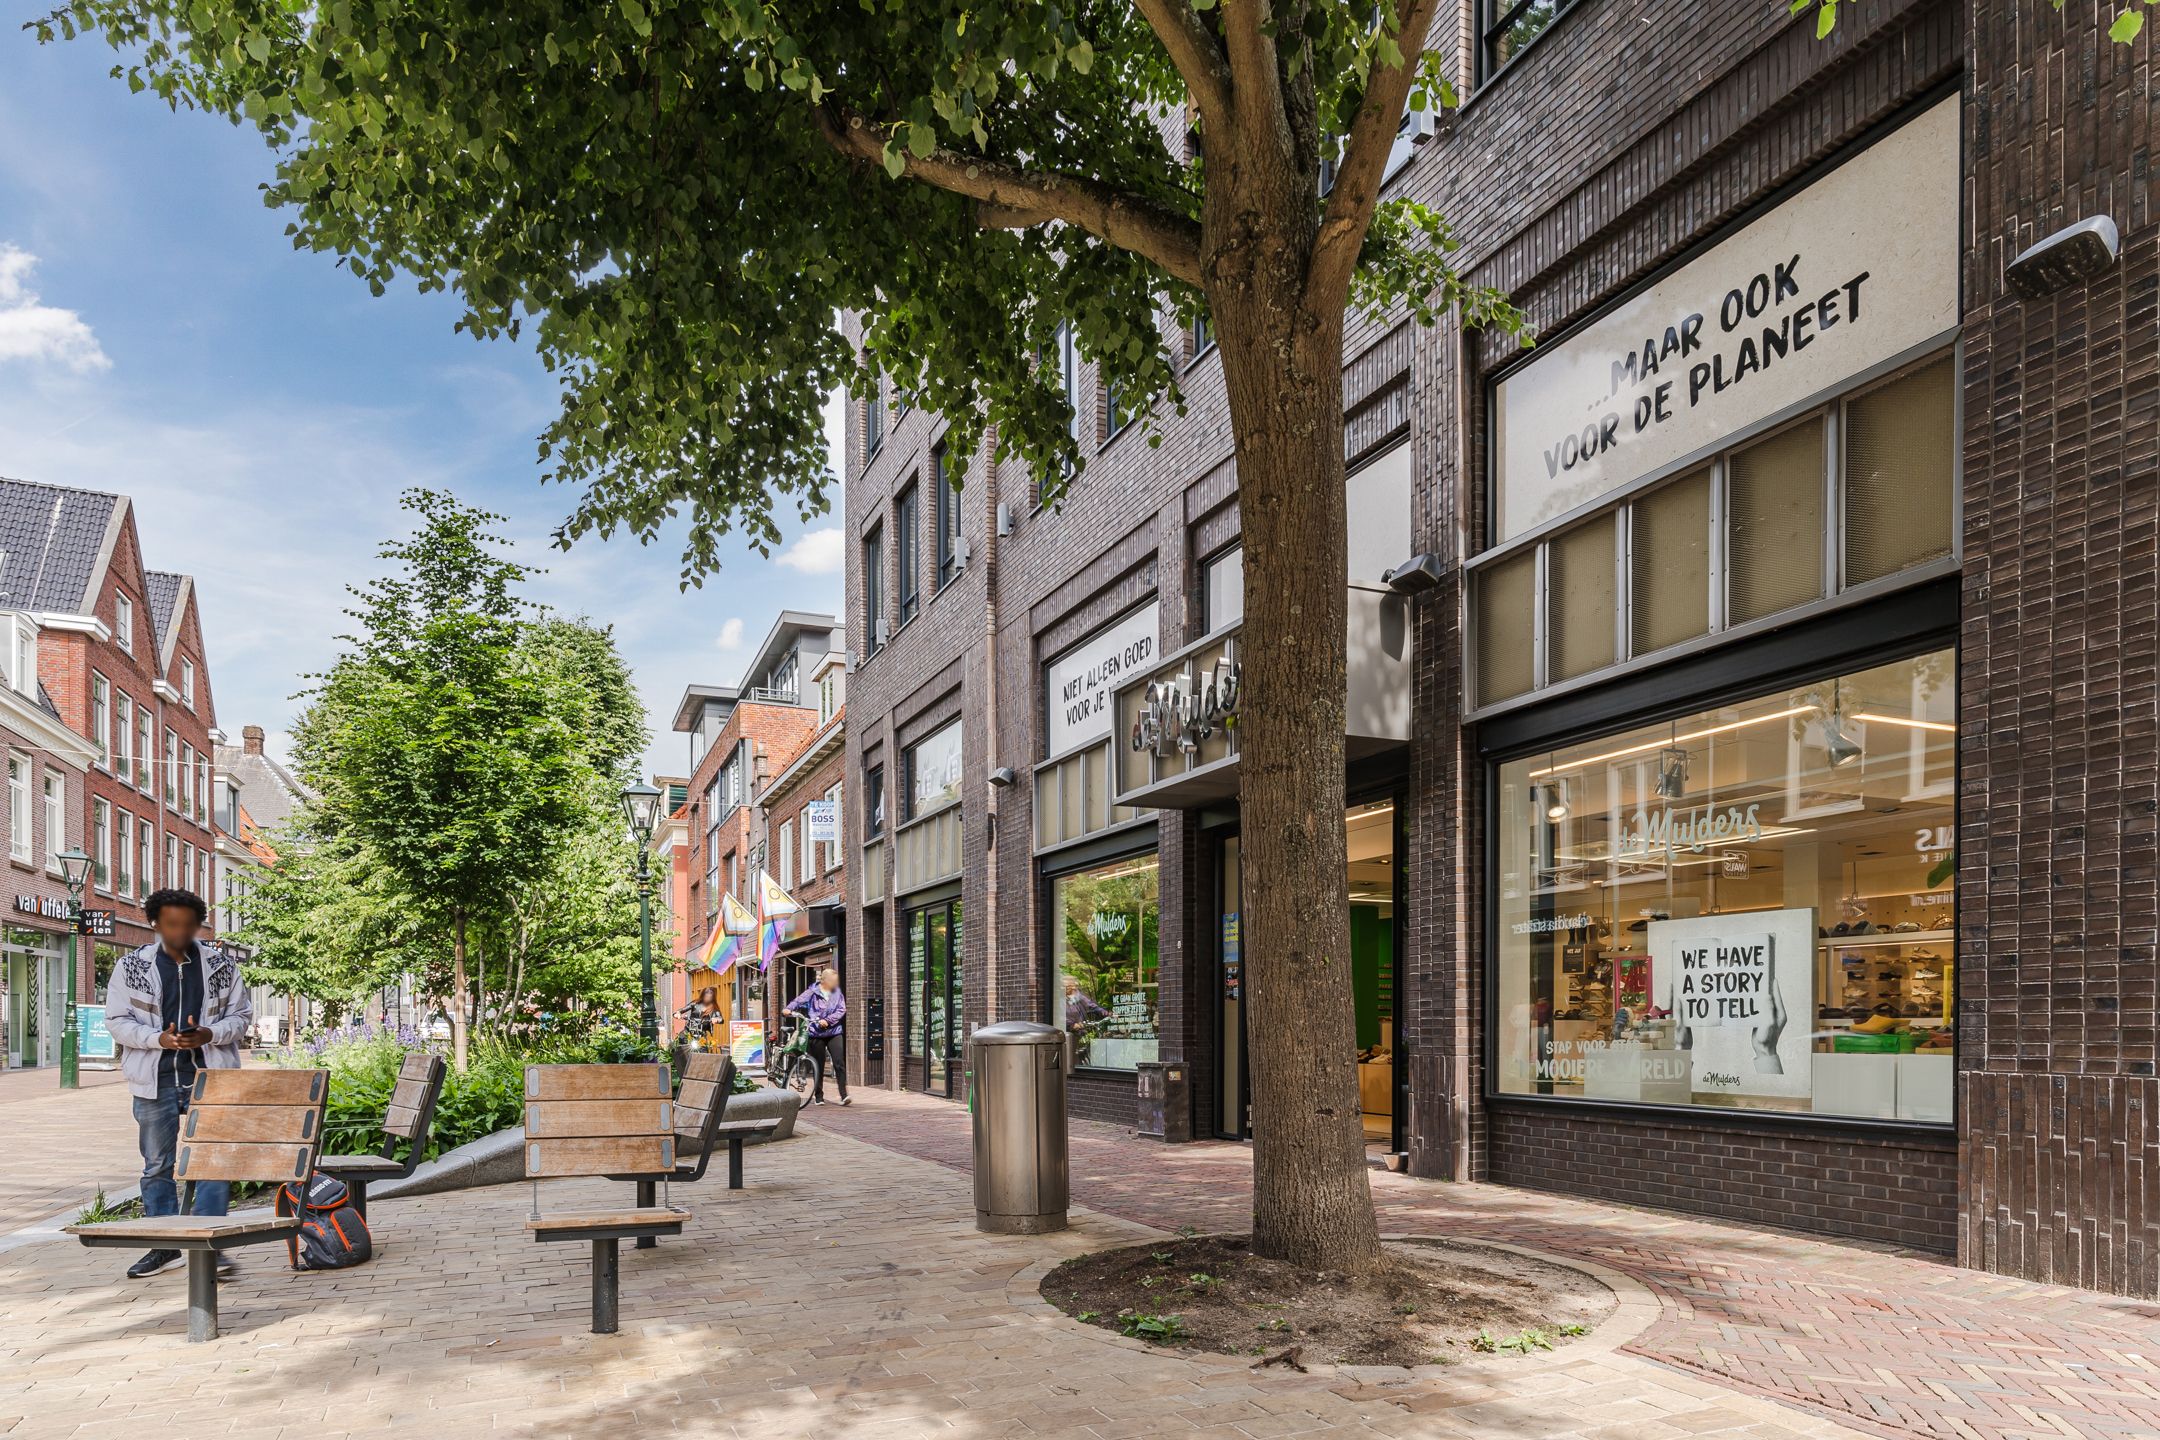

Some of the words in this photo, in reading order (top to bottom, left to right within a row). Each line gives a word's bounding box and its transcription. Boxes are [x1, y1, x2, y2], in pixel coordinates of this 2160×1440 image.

[1720, 254, 1800, 333] OOK
[1543, 412, 1619, 479] VOOR
[1634, 381, 1673, 433] DE
[1689, 271, 1870, 407] PLANEET
[1063, 675, 1083, 704] NIET
[1086, 653, 1121, 691] ALLEEN
[1124, 636, 1152, 670] GOED
[1066, 698, 1090, 726] VOOR
[1093, 690, 1104, 714] JE
[811, 815, 835, 823] BOSS
[1631, 802, 1761, 860] Mulders
[85, 918, 111, 926] uffe
[1094, 912, 1127, 940] Mulders
[1682, 949, 1708, 969] WE
[1717, 946, 1764, 967] HAVE
[1683, 974, 1694, 994] A
[1701, 972, 1764, 994] STORY
[1686, 998, 1709, 1019] TO
[1716, 997, 1759, 1019] TELL
[1546, 1041, 1571, 1054] STAP
[1576, 1040, 1607, 1054] VOOR
[1535, 1058, 1608, 1080] MOOIERE
[1707, 1071, 1741, 1086] Mulders
